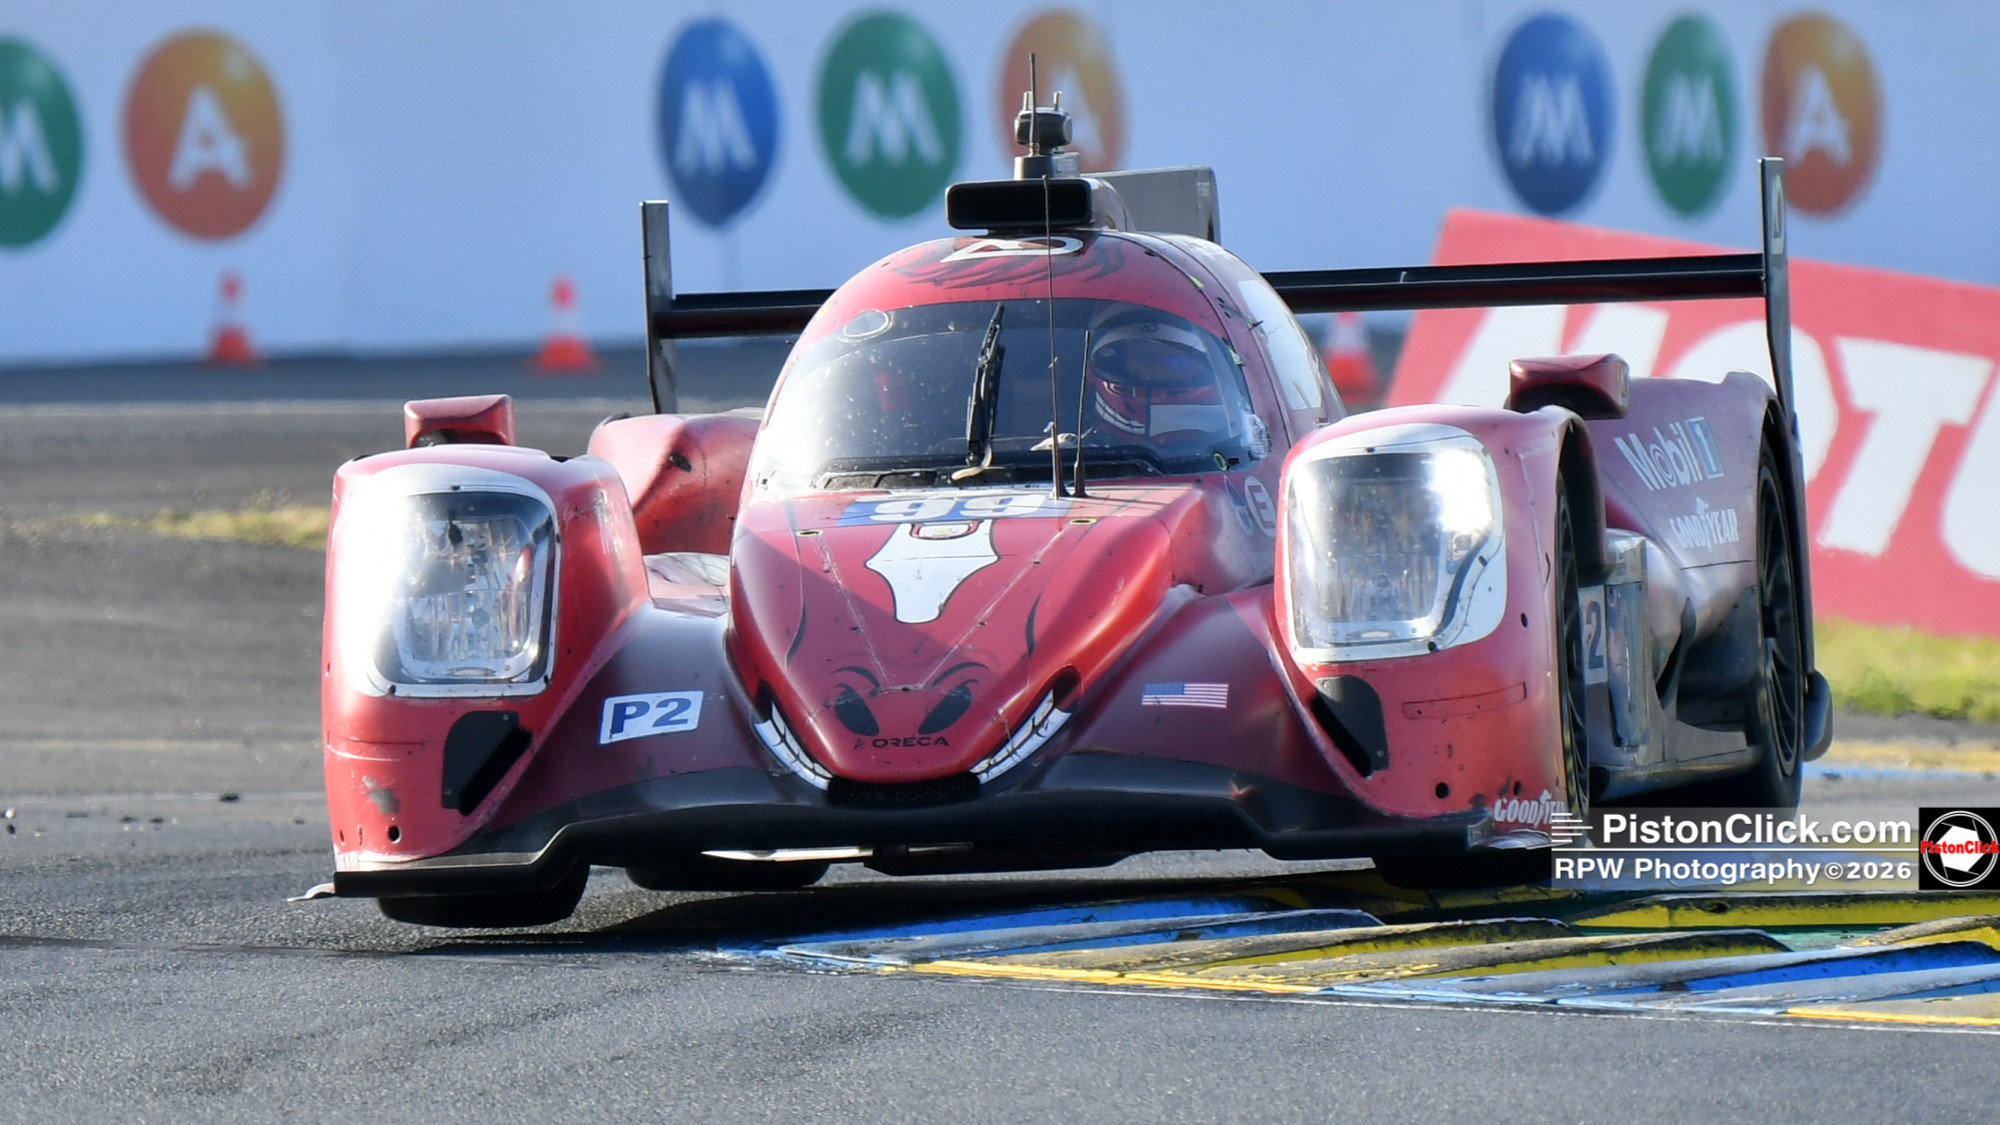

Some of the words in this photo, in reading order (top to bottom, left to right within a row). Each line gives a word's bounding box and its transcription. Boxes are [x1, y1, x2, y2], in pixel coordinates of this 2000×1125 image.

[1614, 421, 1703, 491] Mobil
[869, 494, 1048, 522] 99
[1668, 508, 1739, 549] GOODYEAR
[610, 697, 692, 739] P2
[872, 736, 950, 749] ORECA
